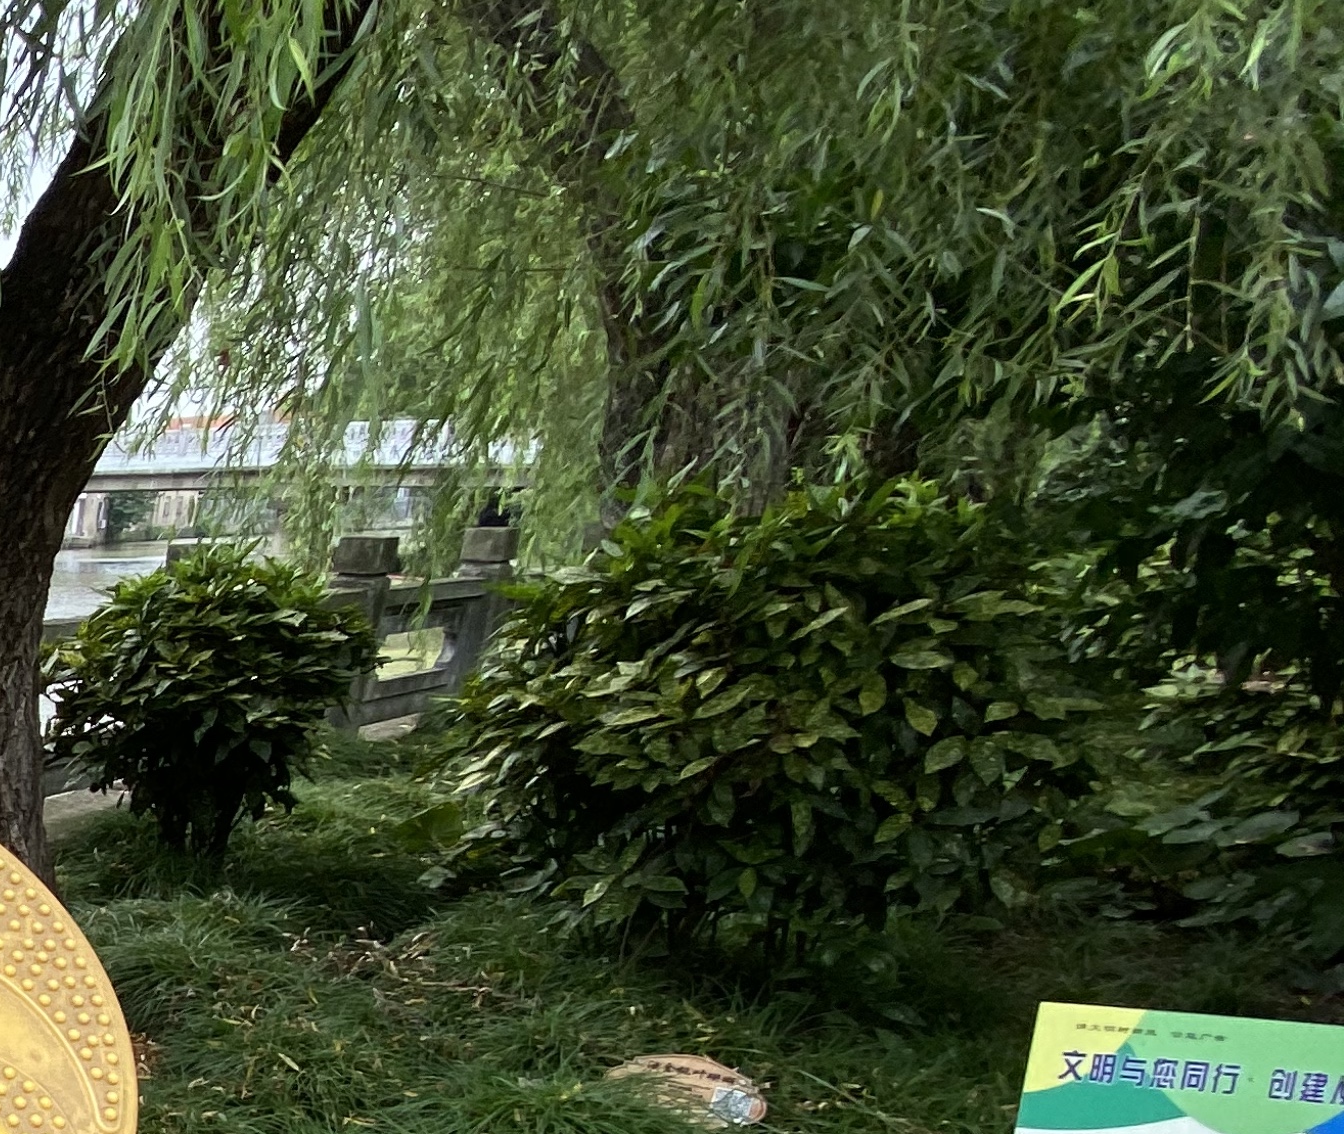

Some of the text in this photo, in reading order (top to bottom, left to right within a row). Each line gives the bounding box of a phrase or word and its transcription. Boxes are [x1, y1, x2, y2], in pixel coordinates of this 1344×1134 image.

[1058, 1050, 1241, 1095] 文明与您同行
